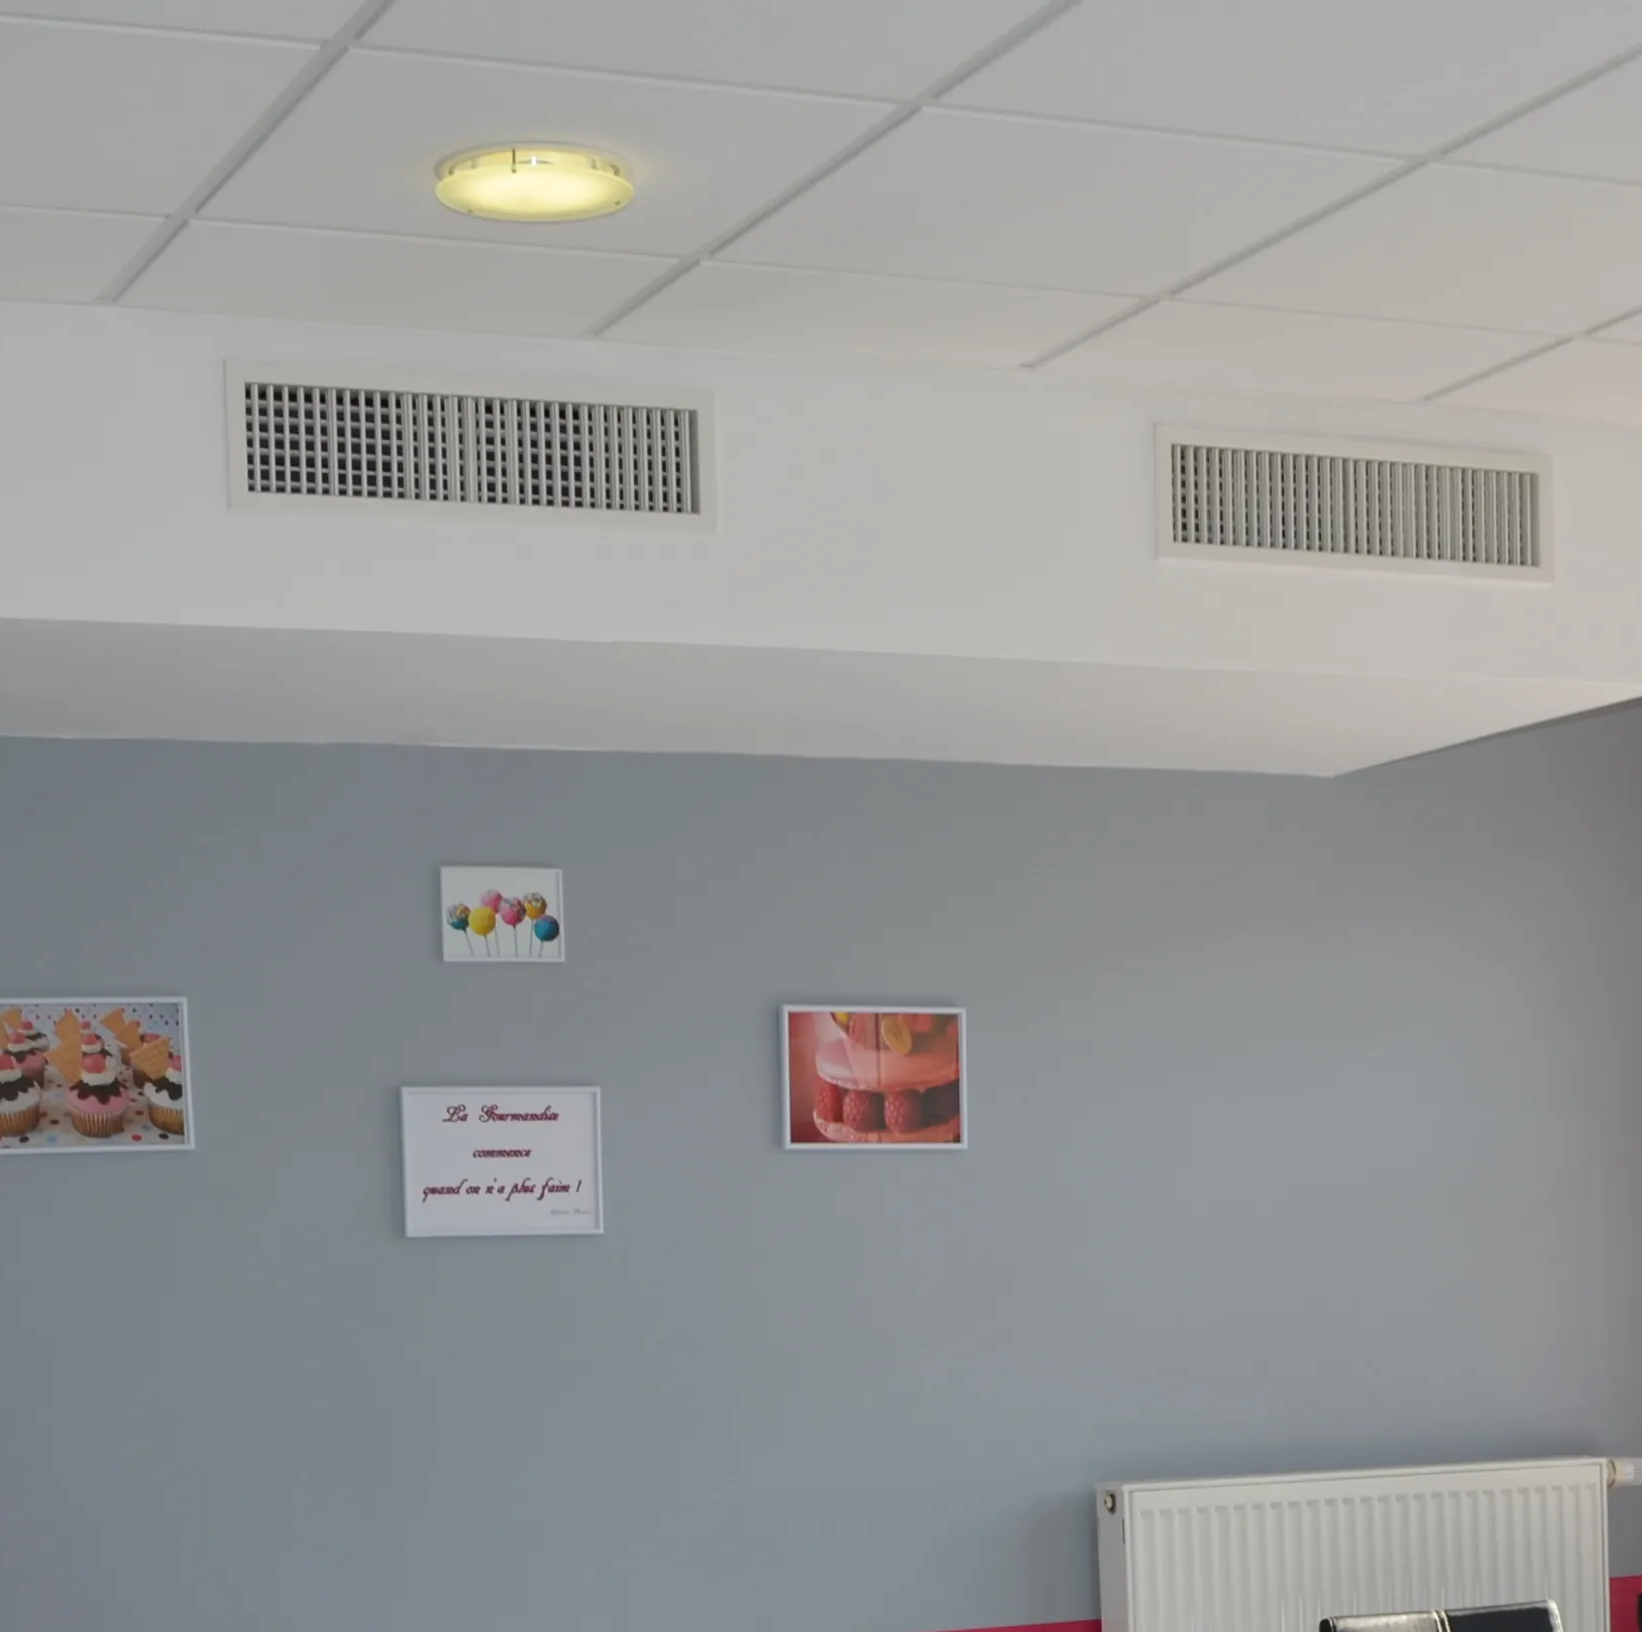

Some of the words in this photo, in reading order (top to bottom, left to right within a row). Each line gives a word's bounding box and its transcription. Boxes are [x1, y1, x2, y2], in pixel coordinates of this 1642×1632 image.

[442, 1104, 468, 1123] La
[422, 1178, 468, 1203] quand
[466, 1185, 481, 1194] on
[485, 1178, 505, 1194] n'a
[505, 1177, 537, 1202] plus
[536, 1177, 570, 1201] faim
[575, 1180, 582, 1193] !
